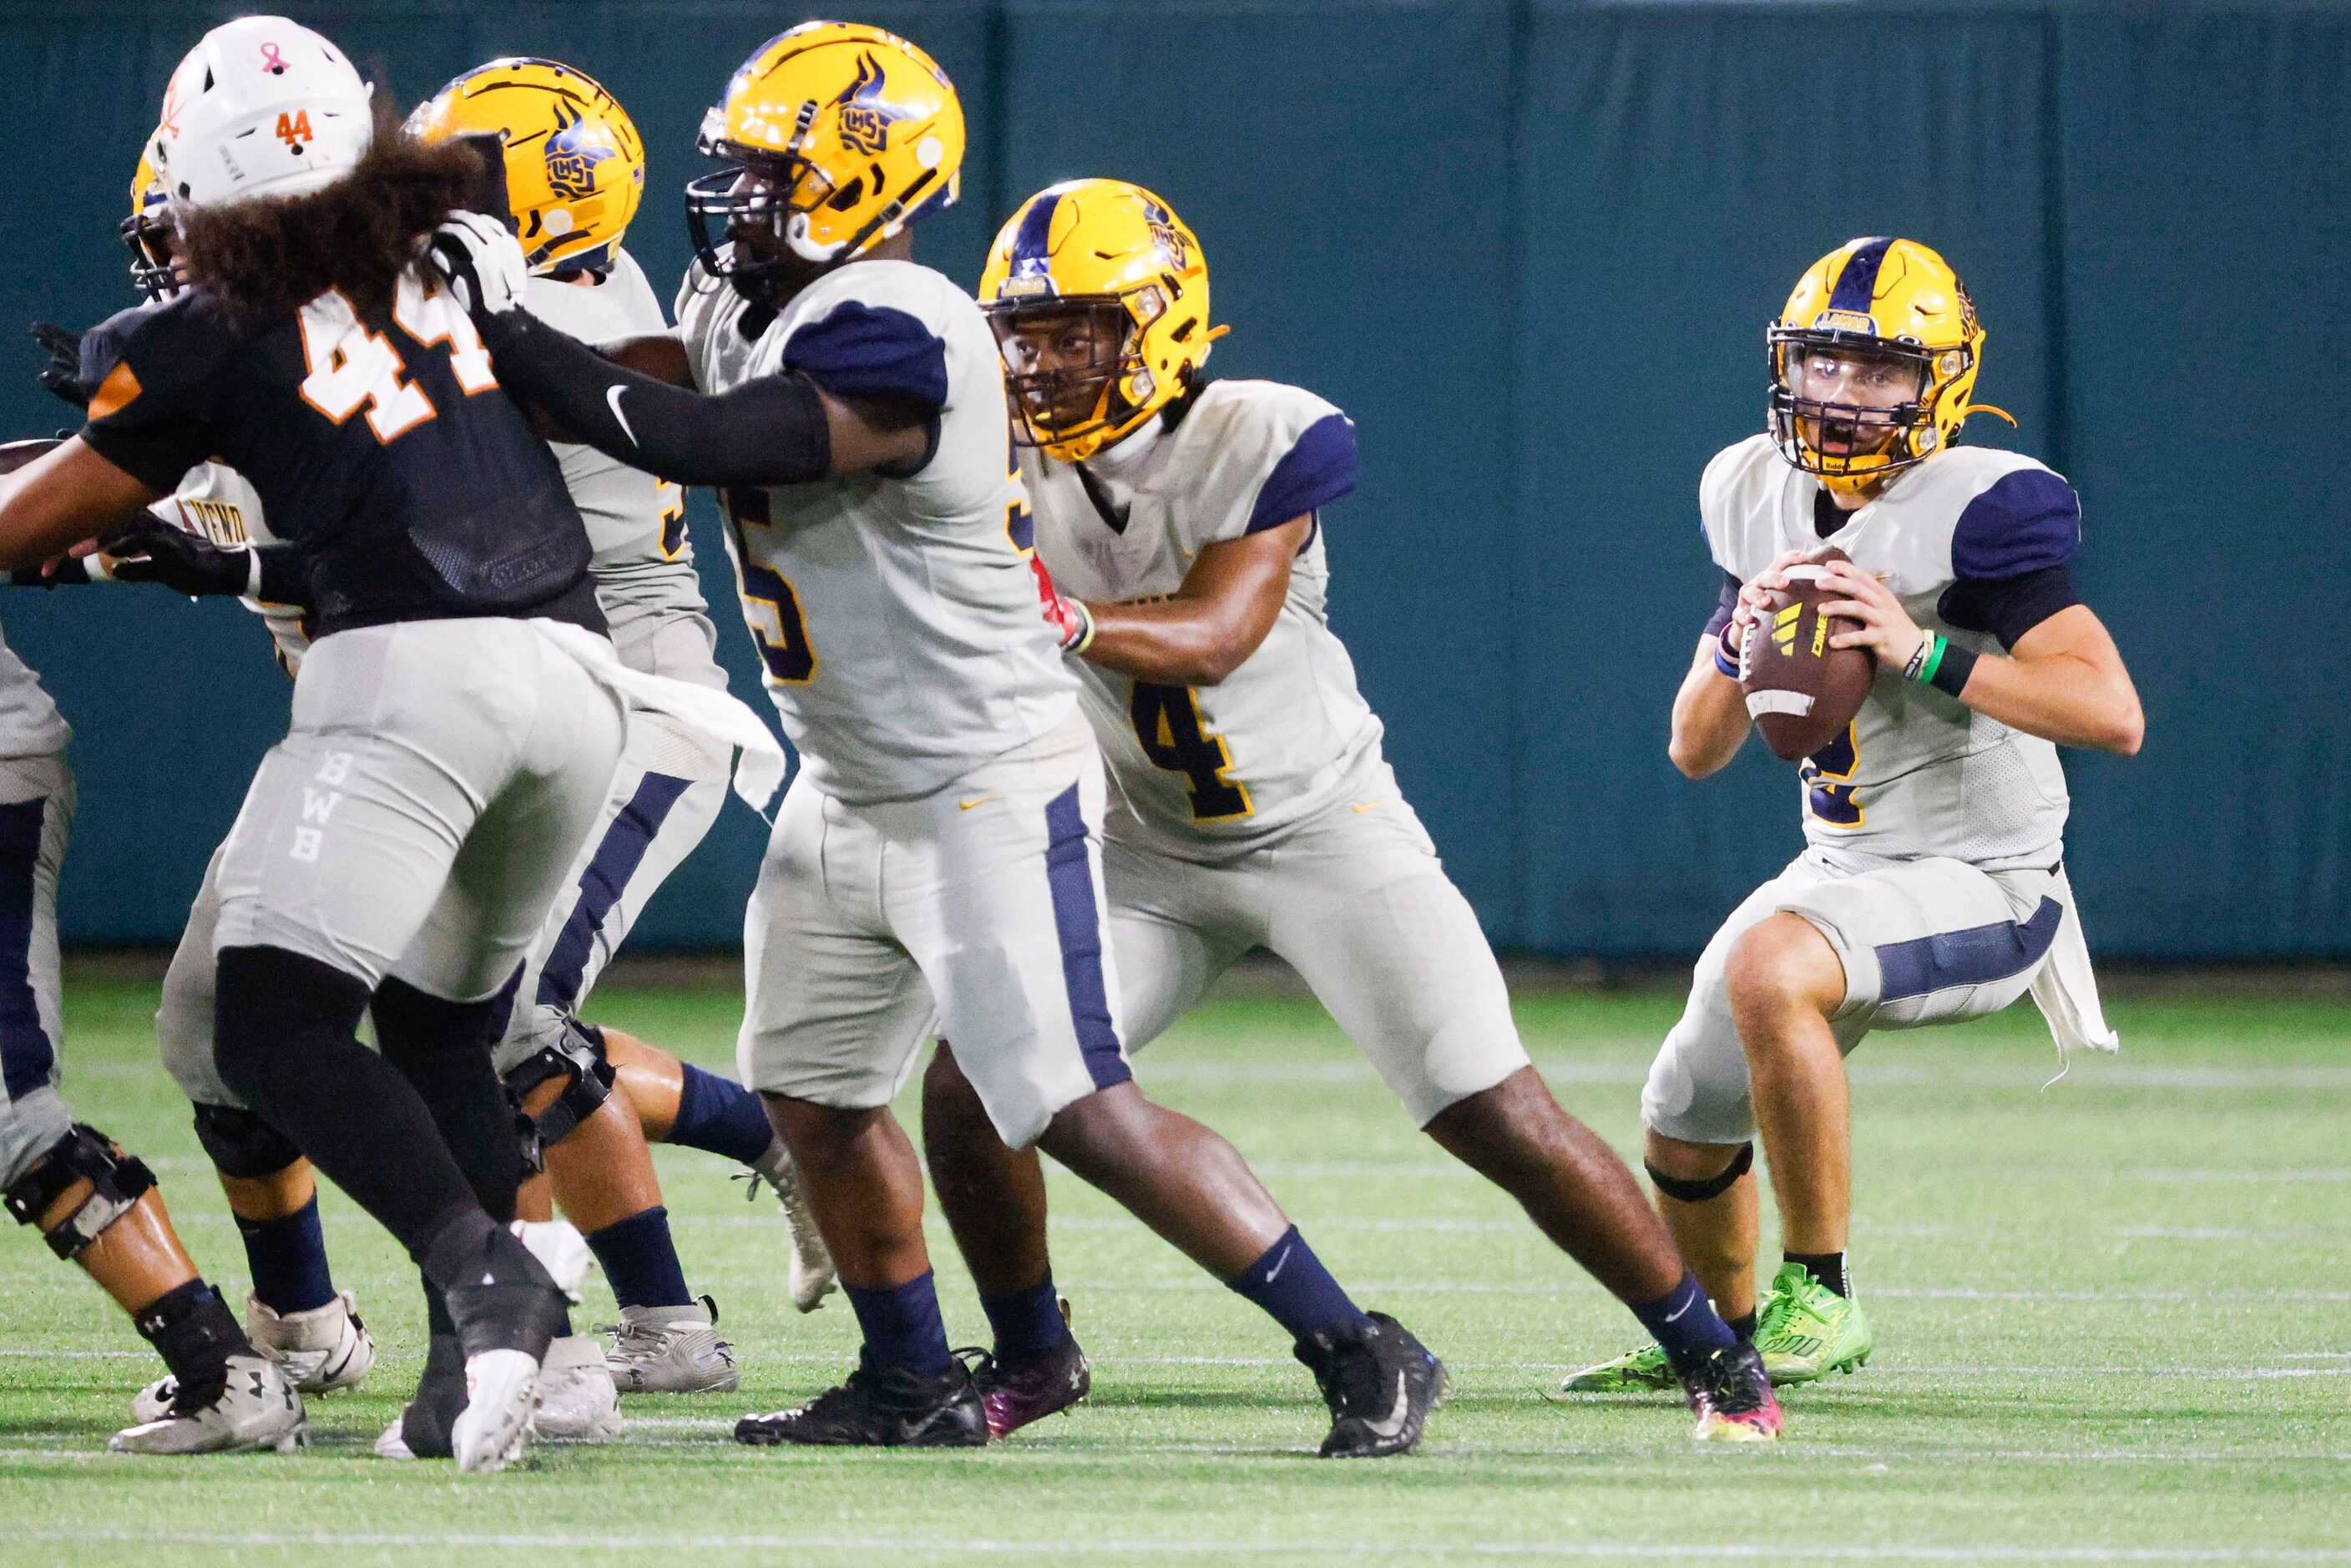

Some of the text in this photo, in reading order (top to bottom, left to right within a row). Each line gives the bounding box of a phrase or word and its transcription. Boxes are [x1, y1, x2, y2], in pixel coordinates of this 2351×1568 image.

[276, 109, 313, 144] 44
[845, 111, 877, 139] LHS
[552, 159, 584, 183] LHS
[1819, 311, 1870, 333] LAMAR
[723, 484, 819, 686] 5
[1130, 678, 1255, 824] 4
